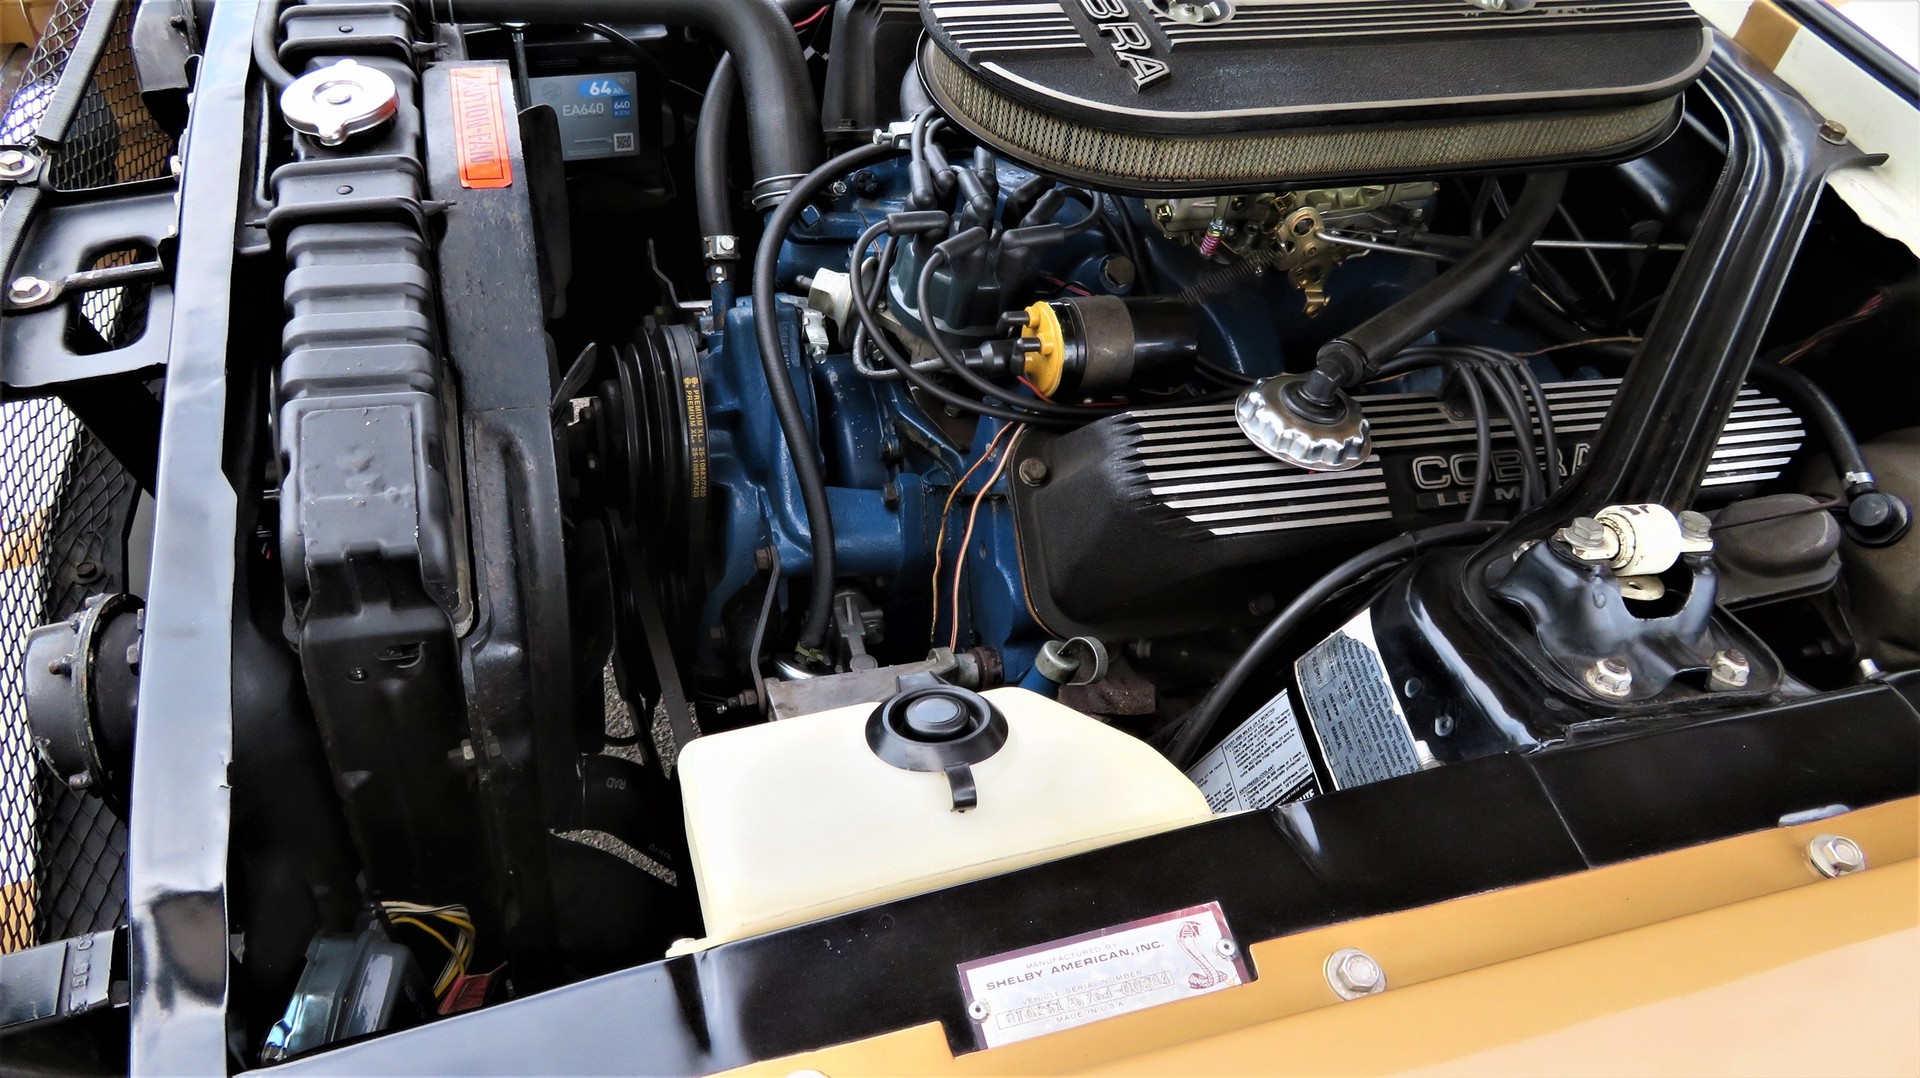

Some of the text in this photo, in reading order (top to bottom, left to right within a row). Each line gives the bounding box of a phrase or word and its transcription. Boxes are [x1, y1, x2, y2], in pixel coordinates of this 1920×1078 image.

[589, 81, 612, 96] 64
[463, 75, 495, 163] AUTION-FAN
[562, 102, 604, 117] EA640
[613, 100, 630, 110] 640
[685, 390, 697, 427] PREMIUM
[692, 389, 703, 427] PREMIUM
[1352, 659, 1361, 679] service
[1358, 698, 1369, 718] service
[1366, 717, 1378, 742] intervals
[1368, 683, 1378, 703] control
[1375, 702, 1386, 723] system
[1384, 721, 1389, 729] of
[1330, 725, 1343, 751] MANUAL
[1337, 719, 1354, 754] AUTOMATIC
[1347, 715, 1359, 739] VEHICLE
[1356, 737, 1366, 757] MODEL
[1386, 708, 1394, 720] this
[1391, 720, 1402, 742] vehicle
[1400, 741, 1408, 754] has
[605, 776, 627, 790] RAD
[1025, 941, 1118, 970] MANUFACTURED BY
[985, 968, 1045, 992] SHELBY
[1021, 969, 1143, 1005] VEHICLE SERIAL NUMBER
[1055, 1010, 1083, 1023] MADE
[1086, 1007, 1097, 1015] IN
